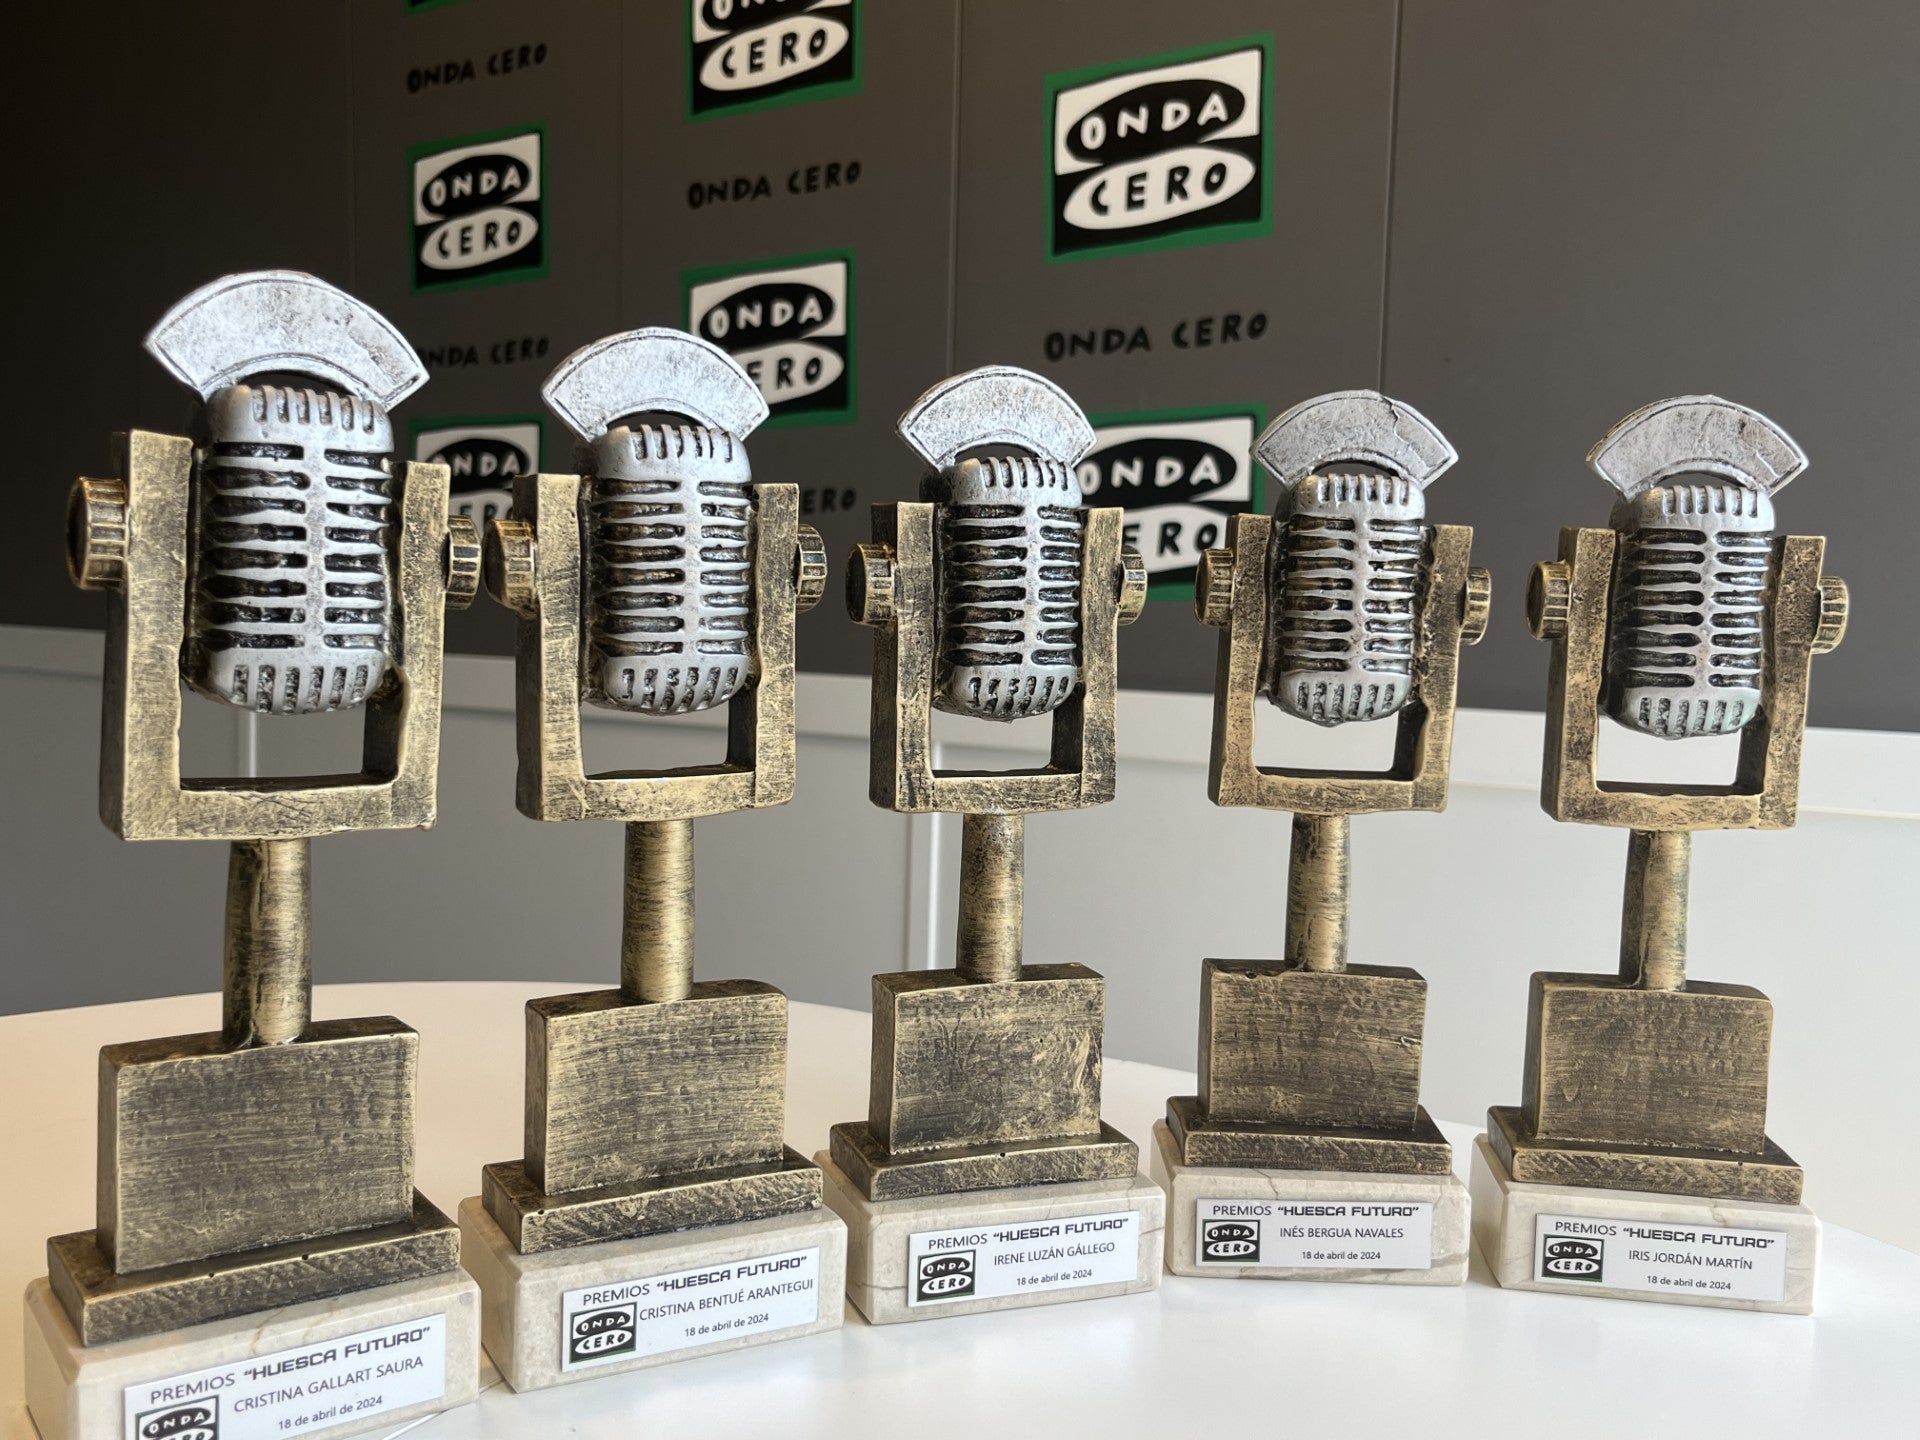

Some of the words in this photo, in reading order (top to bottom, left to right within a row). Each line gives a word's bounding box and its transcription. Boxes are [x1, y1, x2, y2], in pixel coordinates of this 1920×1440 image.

[721, 29, 827, 78] CERO
[407, 58, 476, 93] ONDA
[488, 43, 548, 75] CERO
[1080, 92, 1228, 149] ONDA
[428, 164, 521, 207] ONDA
[687, 177, 771, 209] ONDA
[787, 161, 862, 195] CERO
[1090, 162, 1228, 215] CERO
[437, 219, 521, 259] CERO
[708, 293, 823, 338] ONDA
[1045, 326, 1151, 362] ONDA
[1172, 312, 1268, 349] CERO
[417, 346, 479, 367] NDA
[491, 337, 549, 365] CERO
[747, 356, 822, 390] ERO
[1076, 452, 1221, 496] ONDA
[803, 487, 857, 515] ERO
[1121, 521, 1218, 555] ERO
[1213, 1205, 1272, 1216] PREMIOS
[1211, 1229, 1250, 1237] ONDA
[1280, 1226, 1304, 1238] INÉS
[1308, 1228, 1351, 1238] BERGUA
[1355, 1228, 1404, 1238] NAVALES
[1555, 1222, 1617, 1236] PREMIOS
[928, 1233, 988, 1250] PREMIOS
[994, 1253, 1025, 1266] IRENE
[1028, 1246, 1064, 1262] LUZÁN
[1066, 1241, 1115, 1257] GÁLLEGO
[1213, 1244, 1250, 1253] CERO
[1552, 1245, 1594, 1255] ONDA
[927, 1261, 966, 1274] ONDA
[1302, 1251, 1311, 1260] 18
[1314, 1251, 1325, 1260] de
[1327, 1251, 1345, 1260] abril
[1347, 1251, 1358, 1260] de
[1360, 1251, 1381, 1260] 2024
[1554, 1261, 1592, 1271] CERO
[1629, 1251, 1650, 1262] IRIS
[1653, 1252, 1702, 1266] JORDÁN
[1706, 1256, 1753, 1270] MARTÍN
[928, 1277, 966, 1291] CERO
[1016, 1277, 1025, 1286] 18
[1028, 1275, 1039, 1285] de
[1041, 1272, 1059, 1283] abril
[1061, 1271, 1071, 1281] de
[1073, 1269, 1092, 1279] 2024
[1647, 1276, 1657, 1284] 18
[1660, 1276, 1671, 1286] de
[1674, 1278, 1693, 1287] abril
[1696, 1280, 1707, 1289] de
[1710, 1281, 1731, 1290] 2024
[583, 1284, 650, 1306] PREMIOS
[639, 1301, 695, 1321] CRISTINA
[699, 1289, 745, 1310] BENTUÉ
[747, 1279, 813, 1301] ARANTEGUI
[580, 1315, 625, 1332] ONDA
[684, 1328, 695, 1337] 18
[698, 1324, 710, 1335] de
[712, 1319, 732, 1332] abril
[734, 1317, 745, 1328] de
[748, 1313, 769, 1325] 2024
[583, 1333, 626, 1350] CERO
[150, 1373, 235, 1404] PREMIOS
[234, 1386, 303, 1413] CRISTINA
[308, 1368, 371, 1394] GALLART
[376, 1356, 423, 1378] SAURA
[149, 1412, 205, 1434] ONDA
[278, 1419, 291, 1430] 18
[295, 1413, 309, 1426] de
[312, 1407, 337, 1424] abril
[340, 1402, 354, 1416] de
[356, 1395, 382, 1412] 2024
